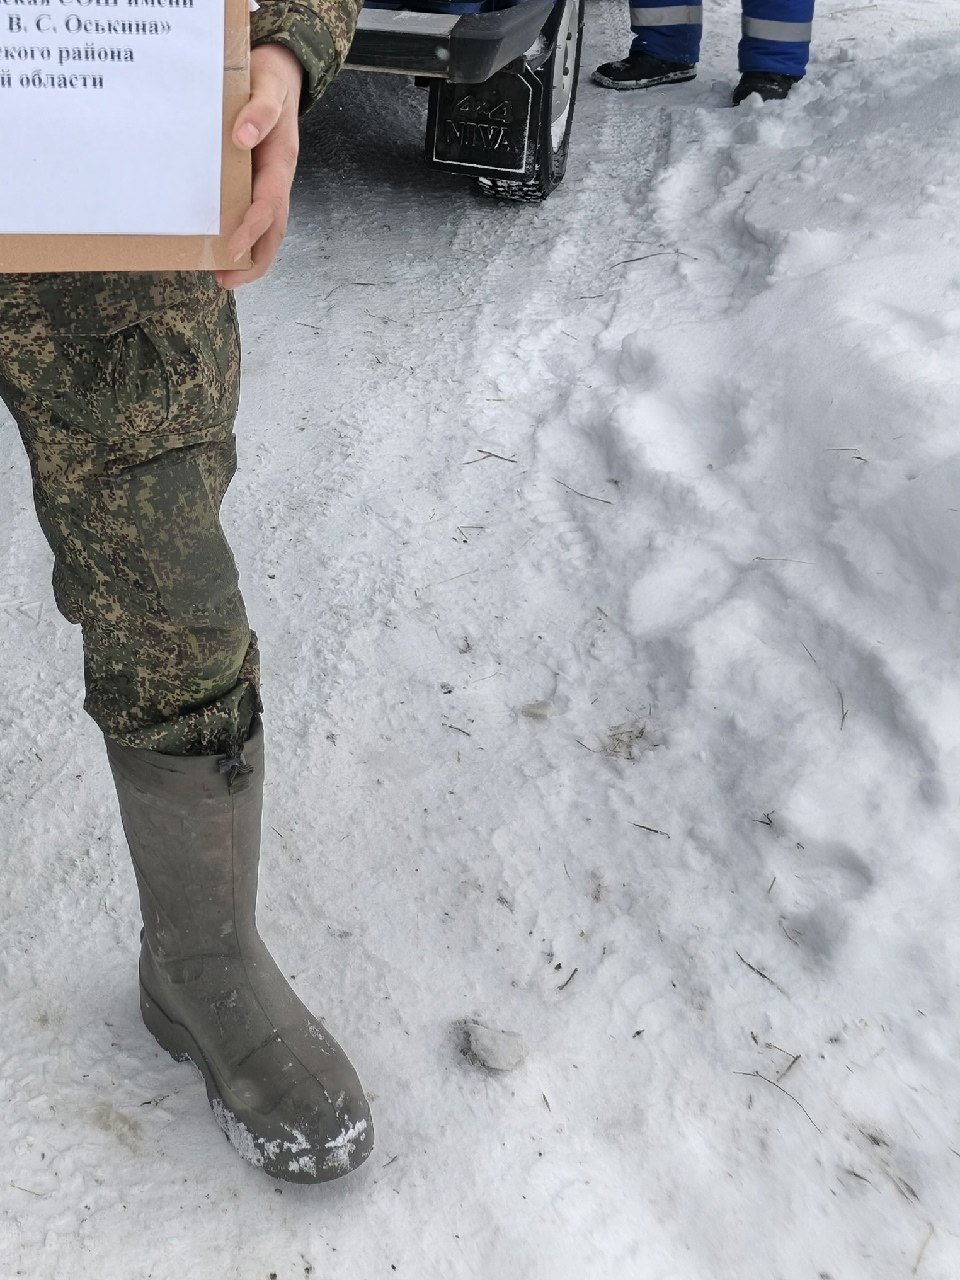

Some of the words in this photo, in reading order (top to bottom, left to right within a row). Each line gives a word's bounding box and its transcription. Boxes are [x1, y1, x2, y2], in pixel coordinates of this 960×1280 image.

[8, 13, 27, 33] В.
[35, 13, 57, 34] С.
[65, 13, 171, 35] Оськина»
[58, 42, 134, 66] района
[20, 69, 103, 89] области
[446, 119, 519, 153] NIVA
